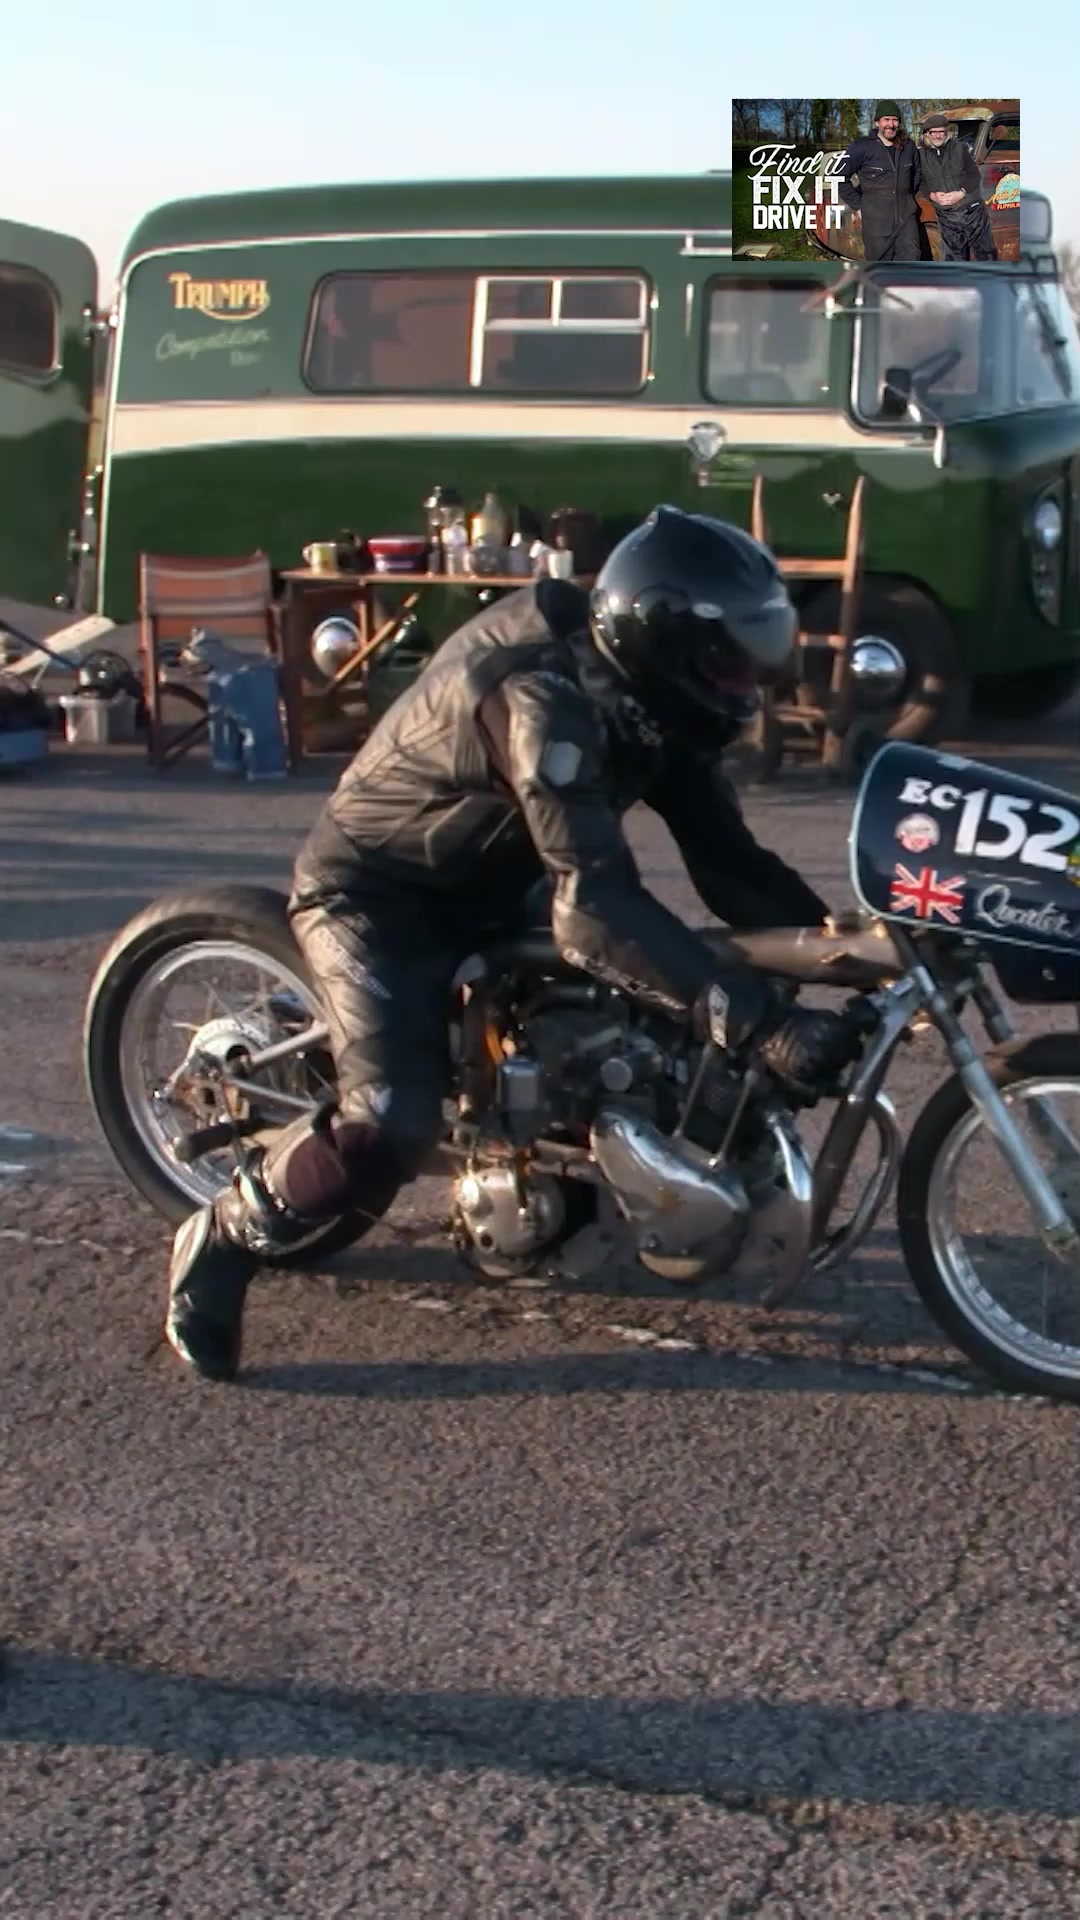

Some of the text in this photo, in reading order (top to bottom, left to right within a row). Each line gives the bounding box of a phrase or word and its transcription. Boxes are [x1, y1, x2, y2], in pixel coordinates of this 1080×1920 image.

[167, 271, 270, 319] TRIUMPH
[898, 776, 1080, 872] EC 152
